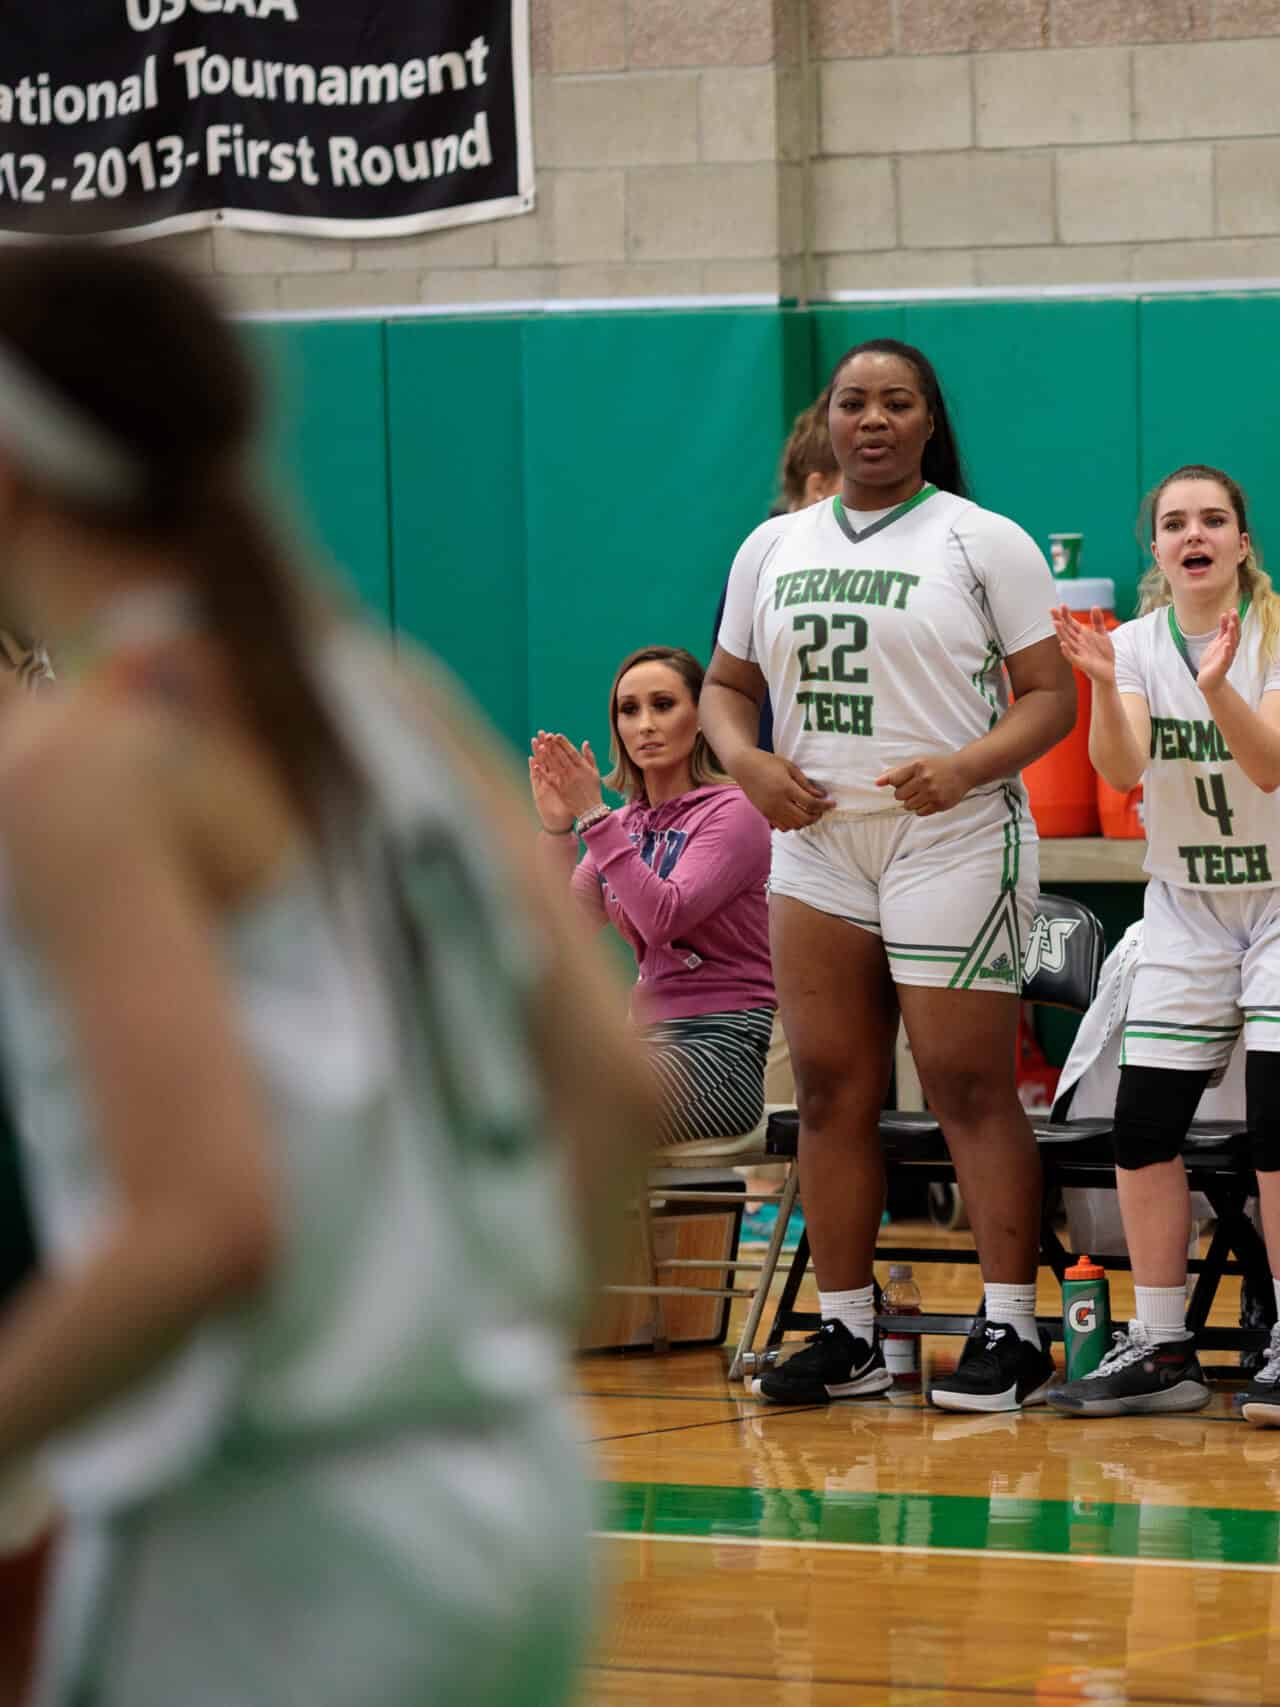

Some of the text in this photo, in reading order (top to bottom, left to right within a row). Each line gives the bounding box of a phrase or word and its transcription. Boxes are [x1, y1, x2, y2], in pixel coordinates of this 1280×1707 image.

[173, 35, 489, 106] Tournament
[328, 111, 492, 187] Round
[774, 568, 920, 611] VERMONT
[793, 613, 869, 683] 22
[796, 691, 874, 736] TECH
[1195, 773, 1234, 836] 4
[1178, 844, 1272, 885] TECH
[1069, 1300, 1096, 1333] G
